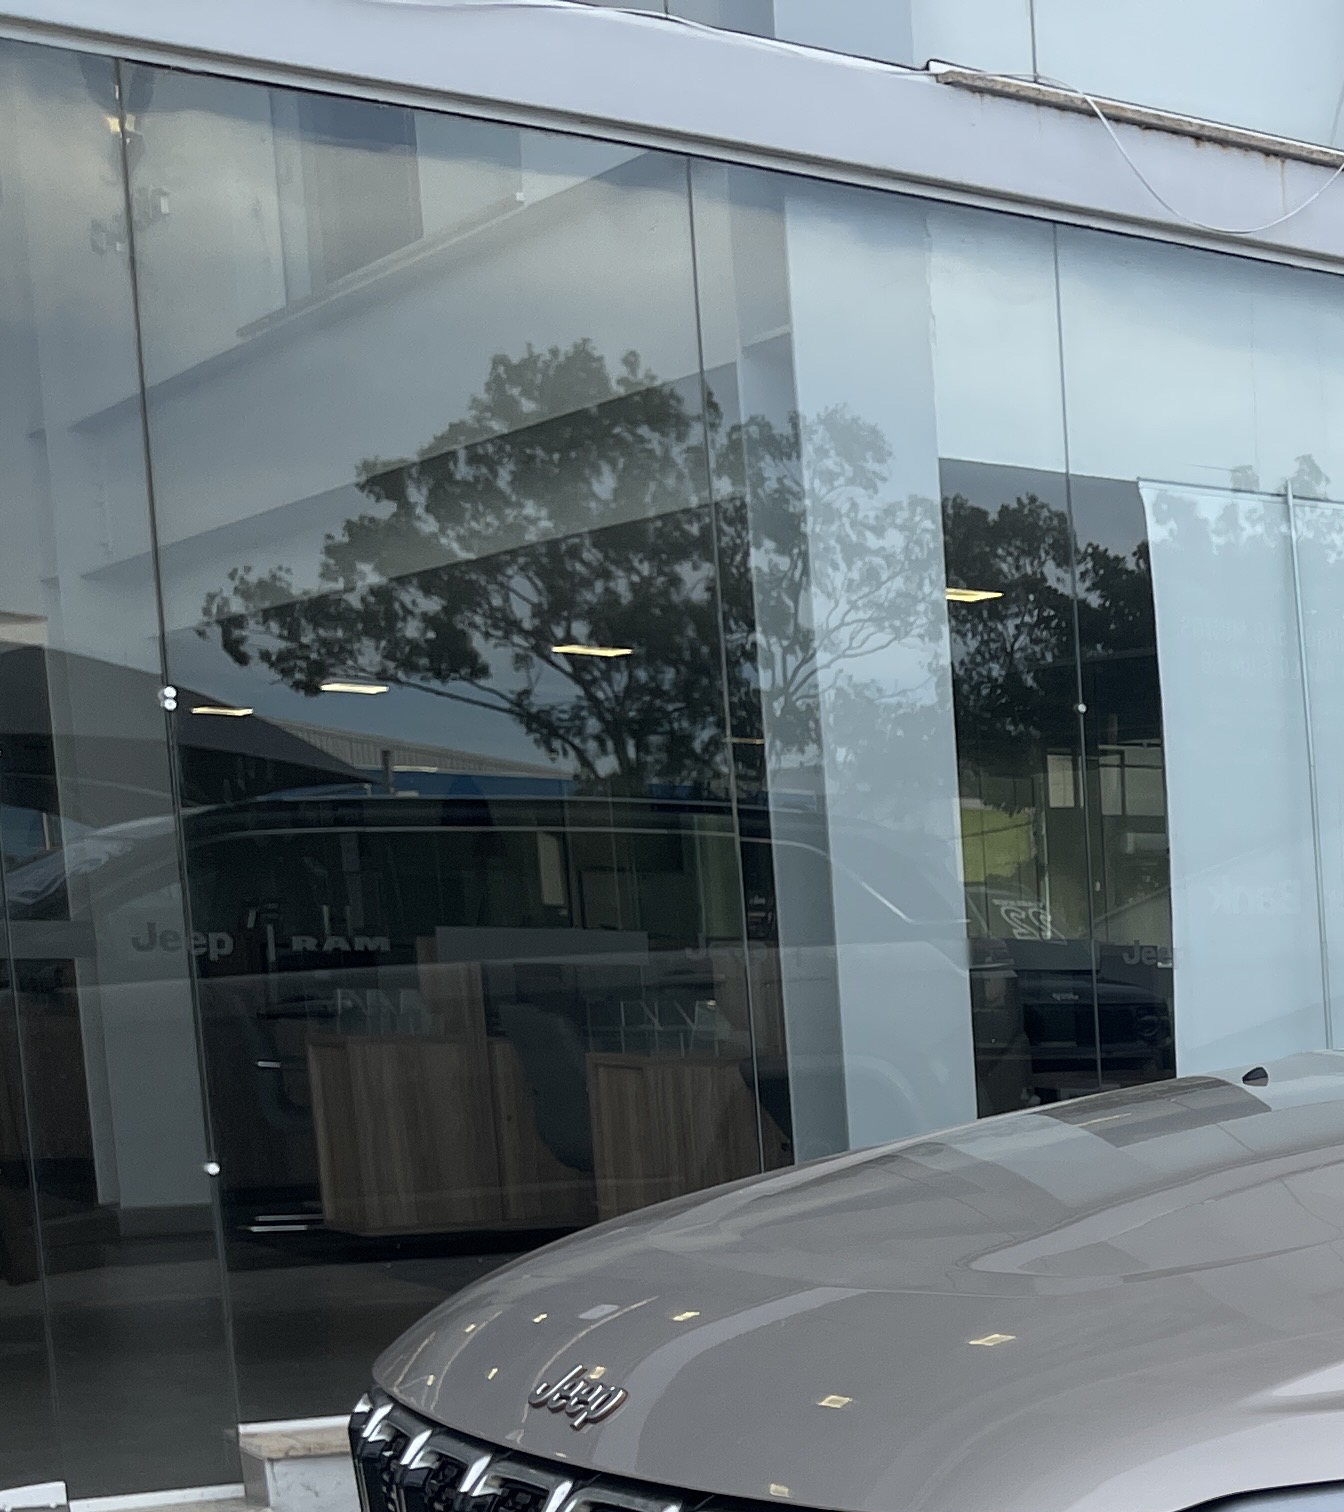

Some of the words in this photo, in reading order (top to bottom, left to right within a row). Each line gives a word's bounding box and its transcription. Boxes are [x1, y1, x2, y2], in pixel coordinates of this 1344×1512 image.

[131, 921, 234, 961] Jeep
[291, 935, 391, 951] RAM
[1122, 940, 1173, 967] Jee
[528, 1365, 628, 1431] Jeep
